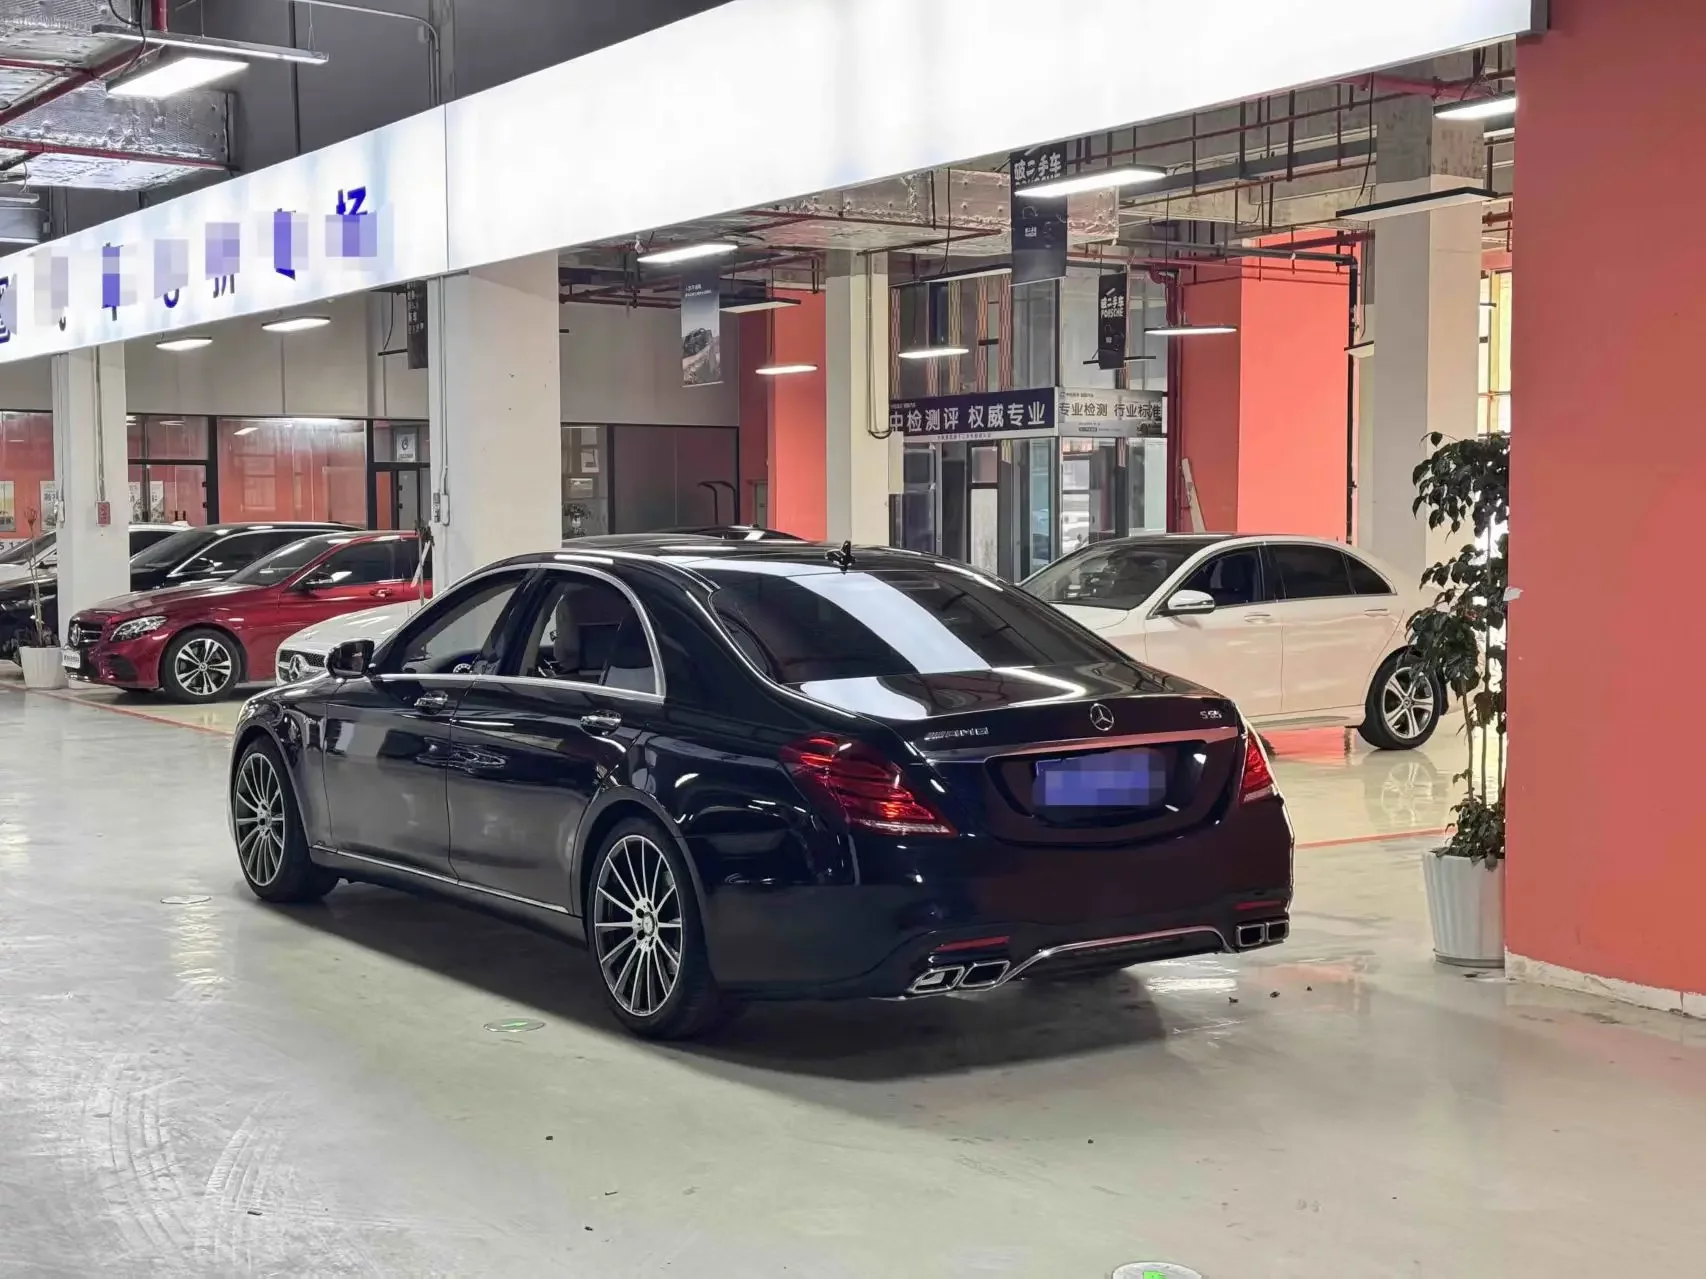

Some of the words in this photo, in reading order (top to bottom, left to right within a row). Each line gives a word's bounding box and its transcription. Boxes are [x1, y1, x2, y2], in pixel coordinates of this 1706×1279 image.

[1100, 308, 1124, 319] PORSCHE
[968, 401, 1046, 429] 权威专业
[1058, 402, 1108, 417] 专业检测
